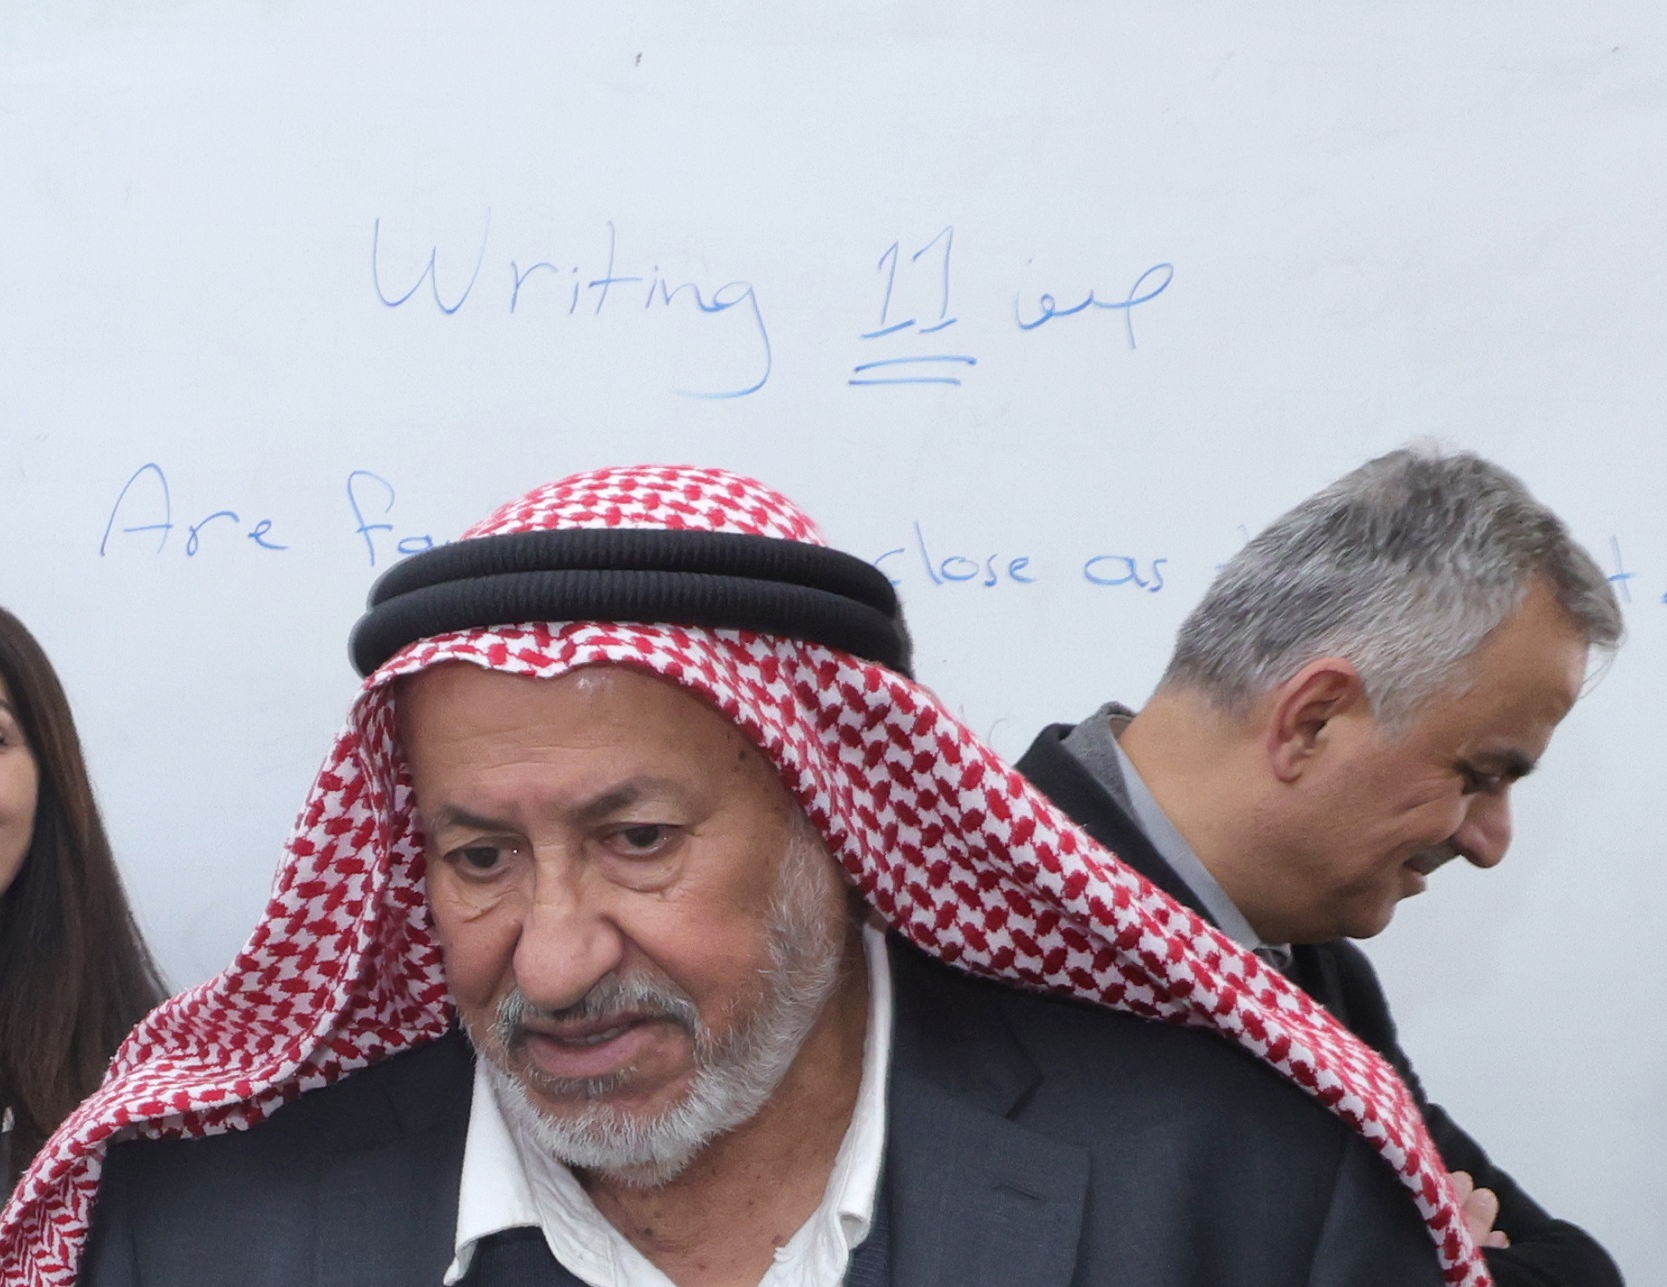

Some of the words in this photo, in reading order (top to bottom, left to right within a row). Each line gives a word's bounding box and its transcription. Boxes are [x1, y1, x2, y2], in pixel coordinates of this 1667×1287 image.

[372, 205, 772, 399] Writing
[100, 462, 289, 557] Are
[1084, 553, 1169, 593] as
